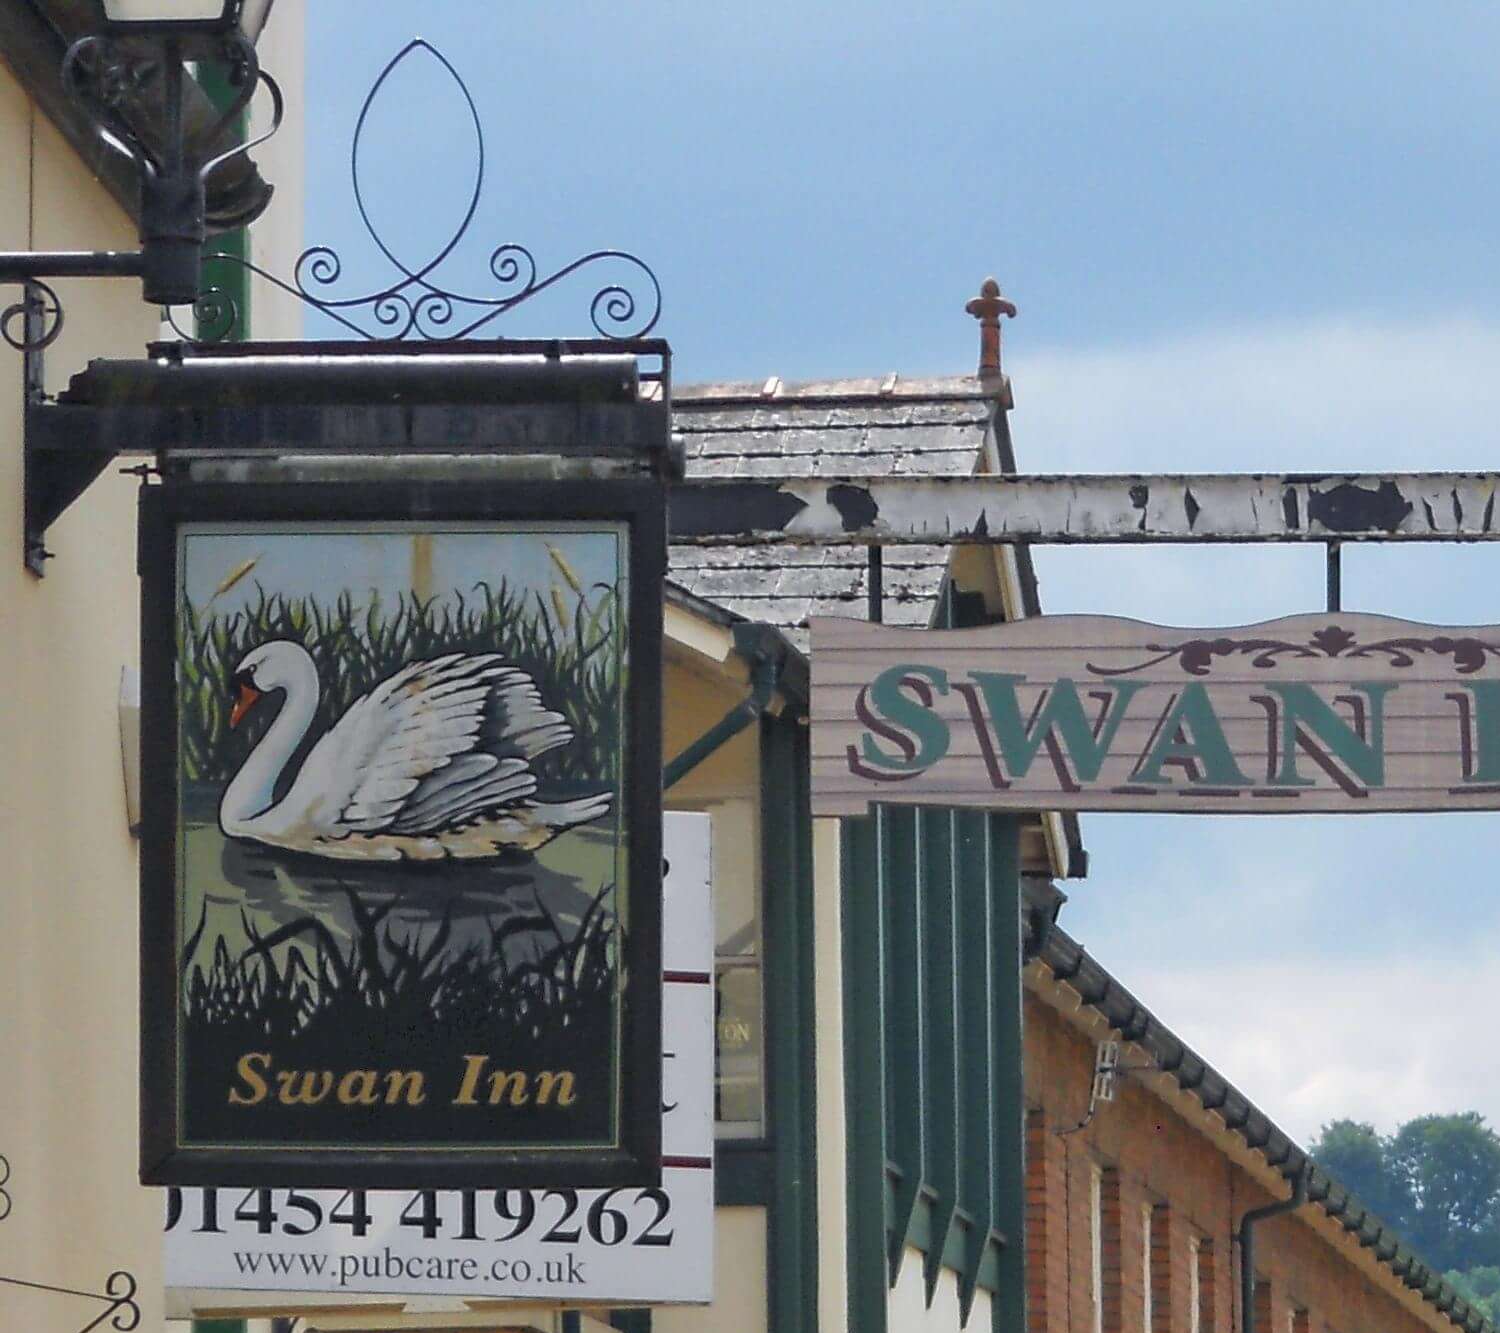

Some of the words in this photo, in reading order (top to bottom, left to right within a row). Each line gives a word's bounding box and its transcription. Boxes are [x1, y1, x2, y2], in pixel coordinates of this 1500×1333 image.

[848, 663, 1399, 797] SWAN
[228, 1052, 426, 1106] Swan
[451, 1054, 577, 1106] Inn
[399, 1187, 675, 1247] 419262
[233, 1247, 587, 1285] www.pubcare.co.uk
